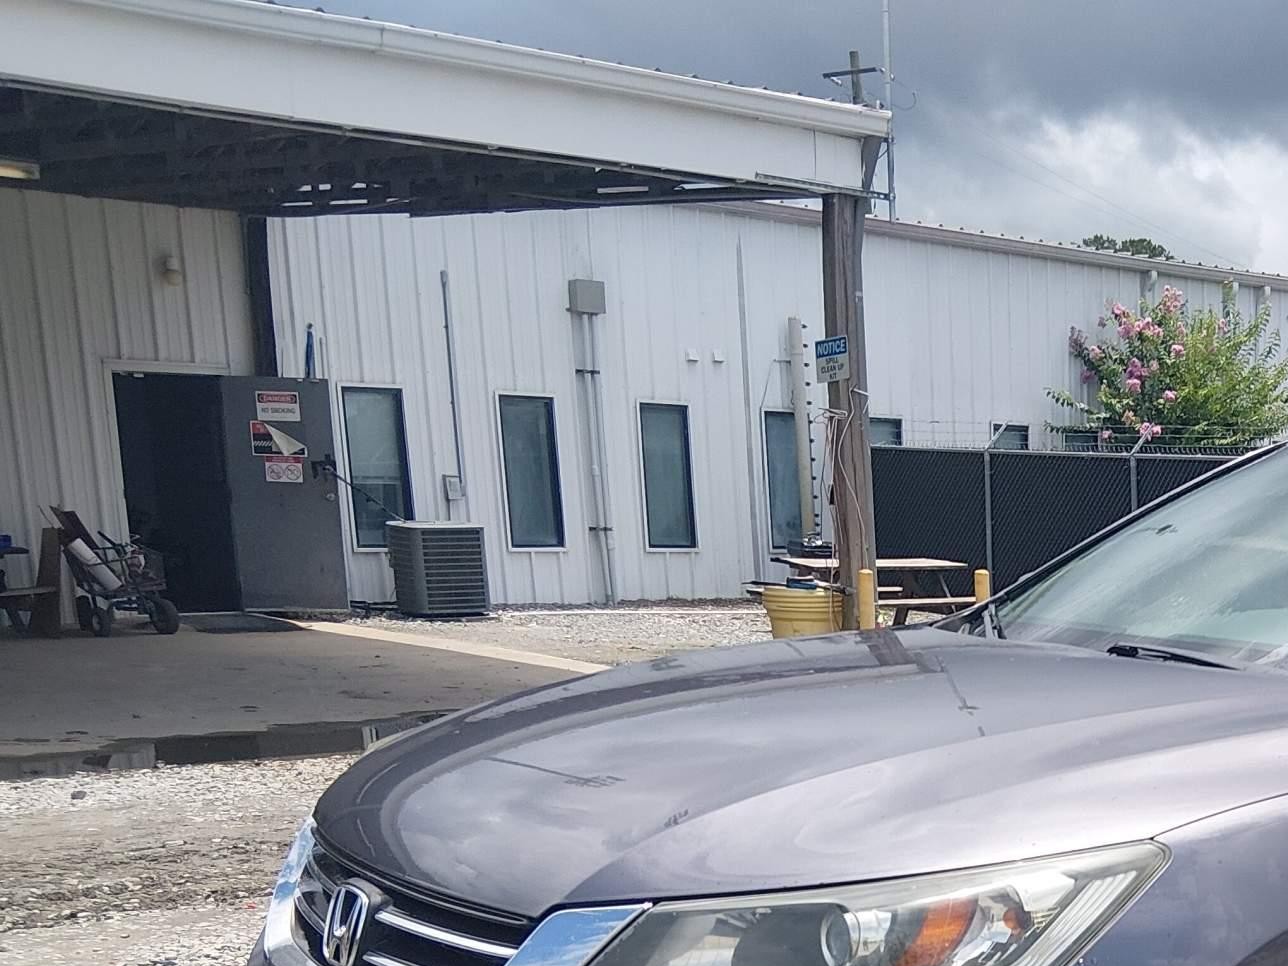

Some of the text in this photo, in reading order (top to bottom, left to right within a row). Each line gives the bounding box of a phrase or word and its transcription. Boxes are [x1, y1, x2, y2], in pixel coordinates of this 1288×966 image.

[817, 340, 845, 355] NOTICE
[825, 357, 838, 365] SPILL
[821, 363, 845, 374] CLEAN UP
